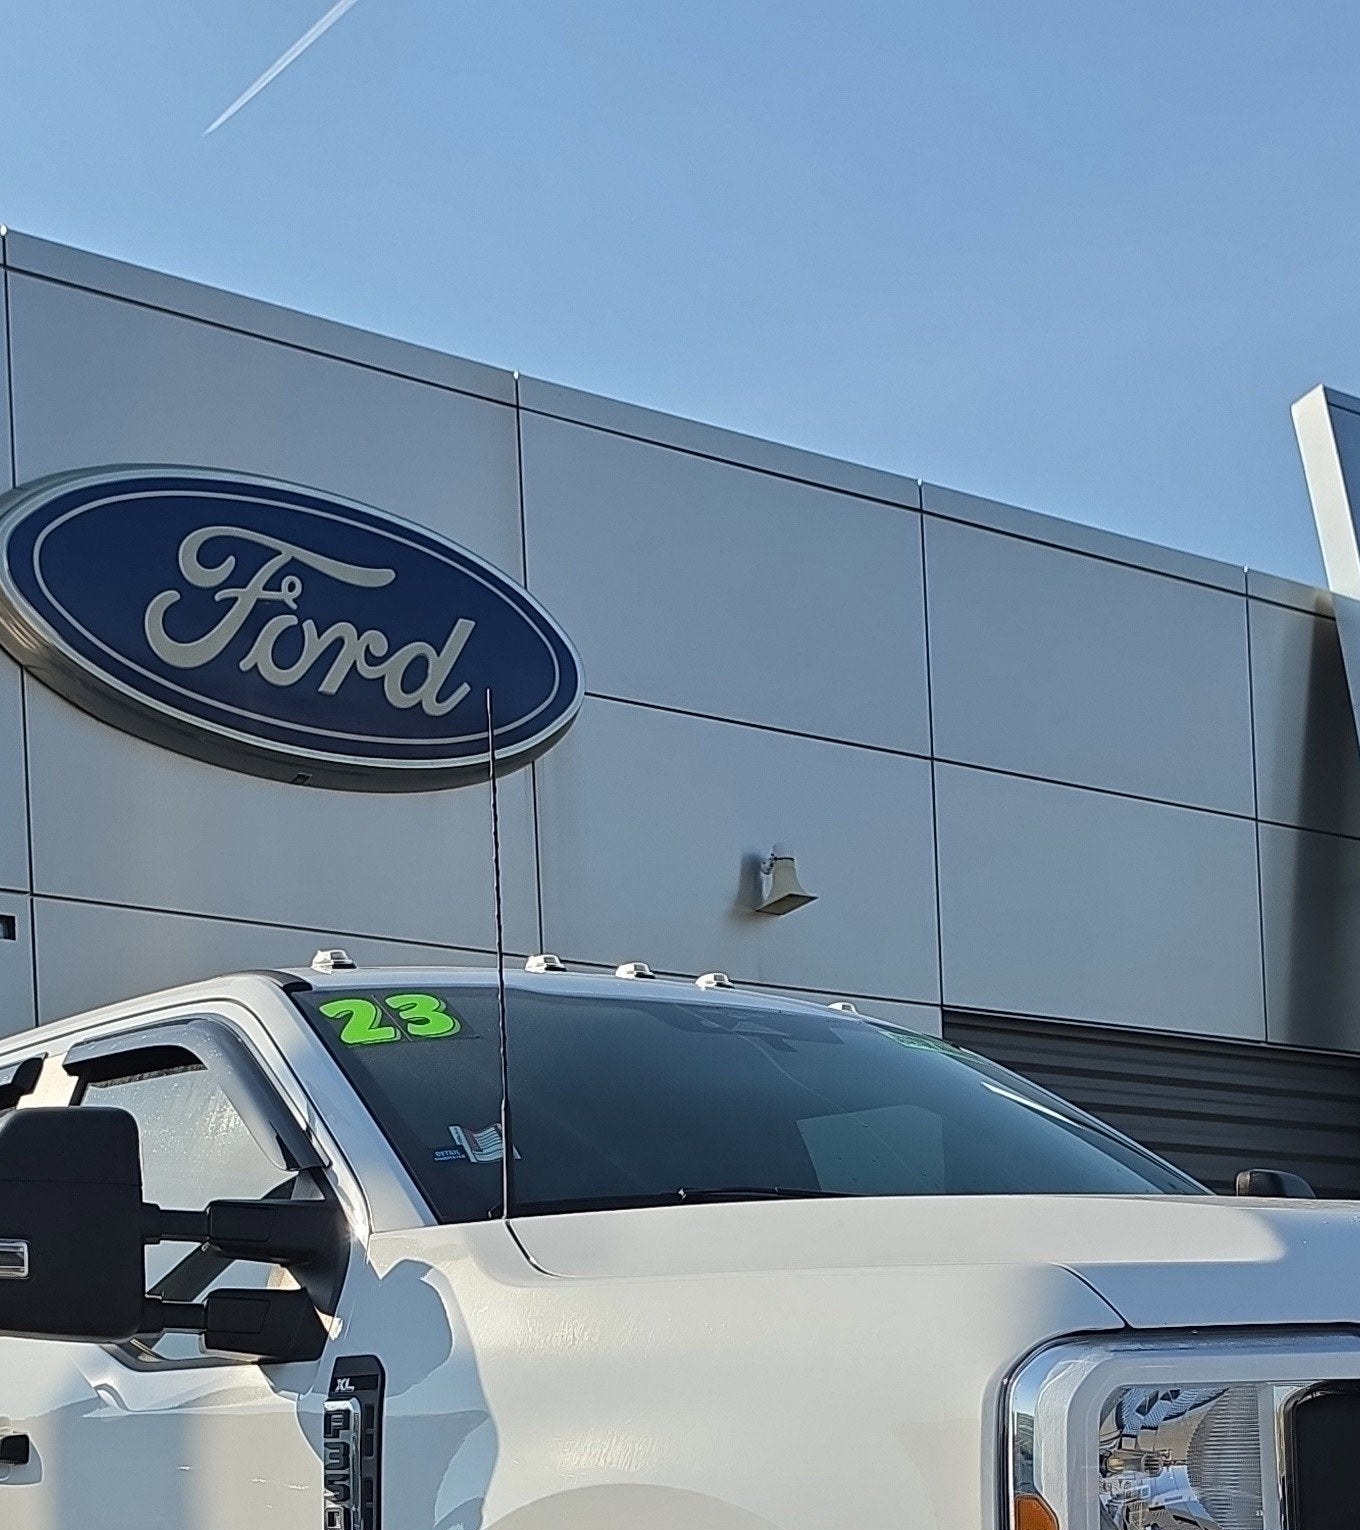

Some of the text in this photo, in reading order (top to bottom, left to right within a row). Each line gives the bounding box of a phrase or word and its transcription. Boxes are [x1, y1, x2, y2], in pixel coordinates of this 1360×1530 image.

[145, 526, 476, 717] Ford
[319, 993, 462, 1044] 23
[335, 1378, 355, 1392] XL
